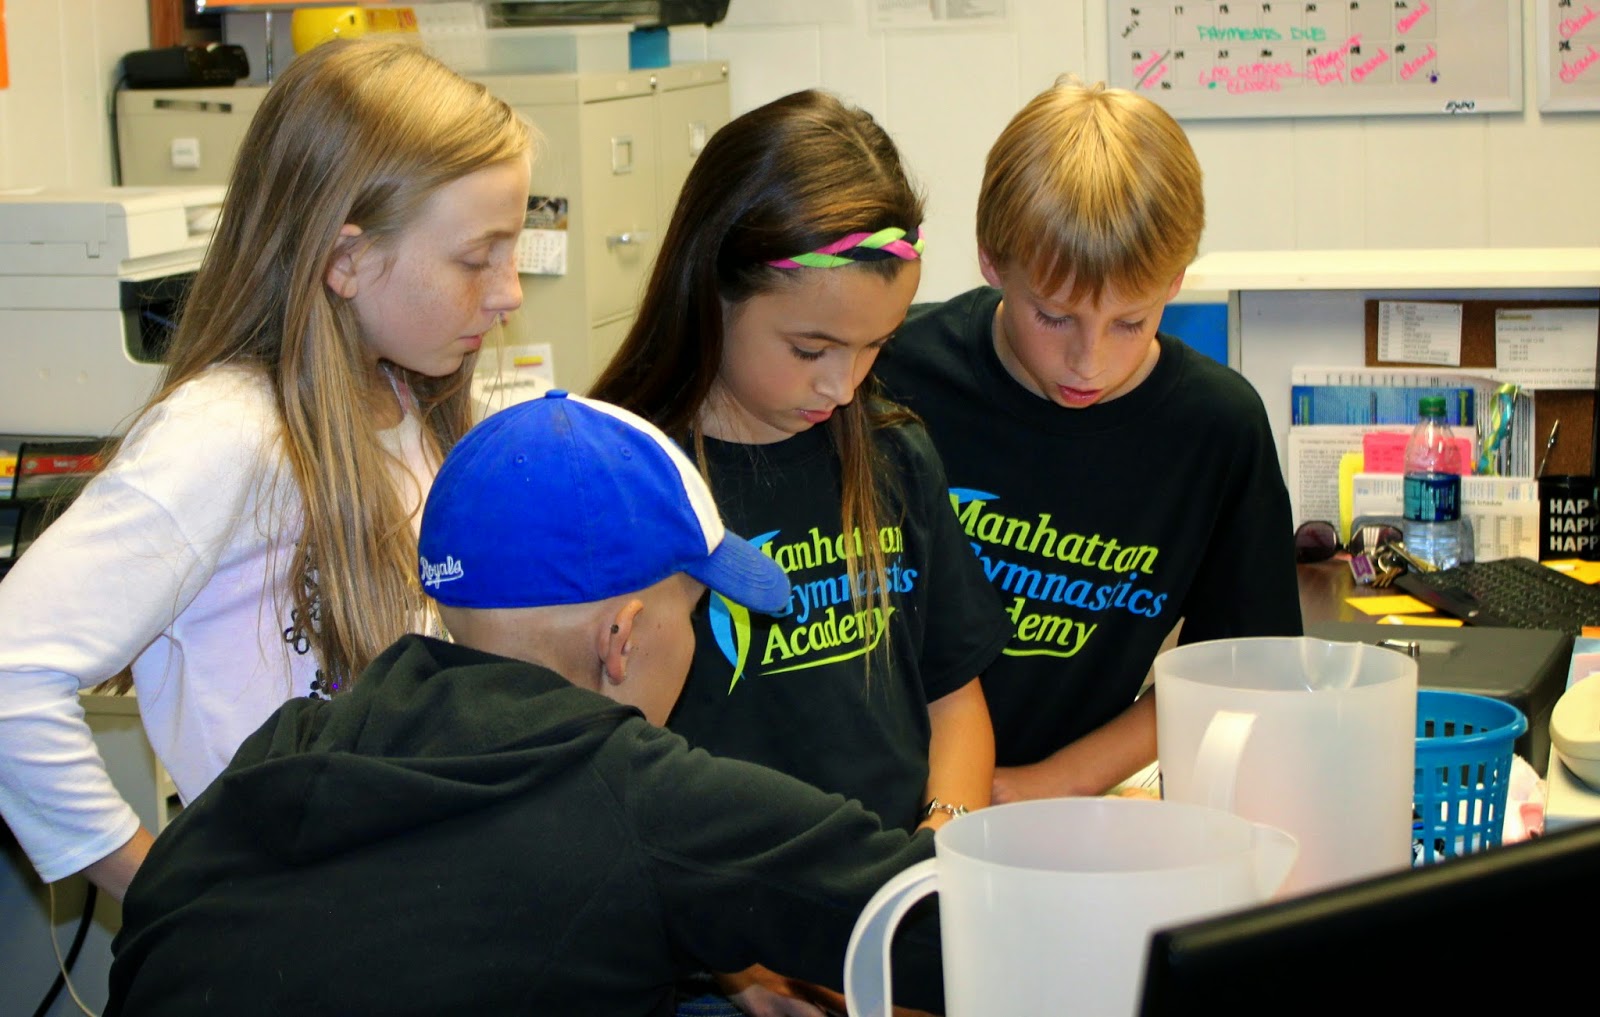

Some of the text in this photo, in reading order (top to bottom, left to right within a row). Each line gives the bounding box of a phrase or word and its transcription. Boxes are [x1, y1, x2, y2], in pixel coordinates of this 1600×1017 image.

[1174, 6, 1184, 15] 17
[1196, 25, 1327, 41] PAYMENTS DUE
[419, 554, 464, 589] Royals
[969, 542, 1168, 618] ymnastics
